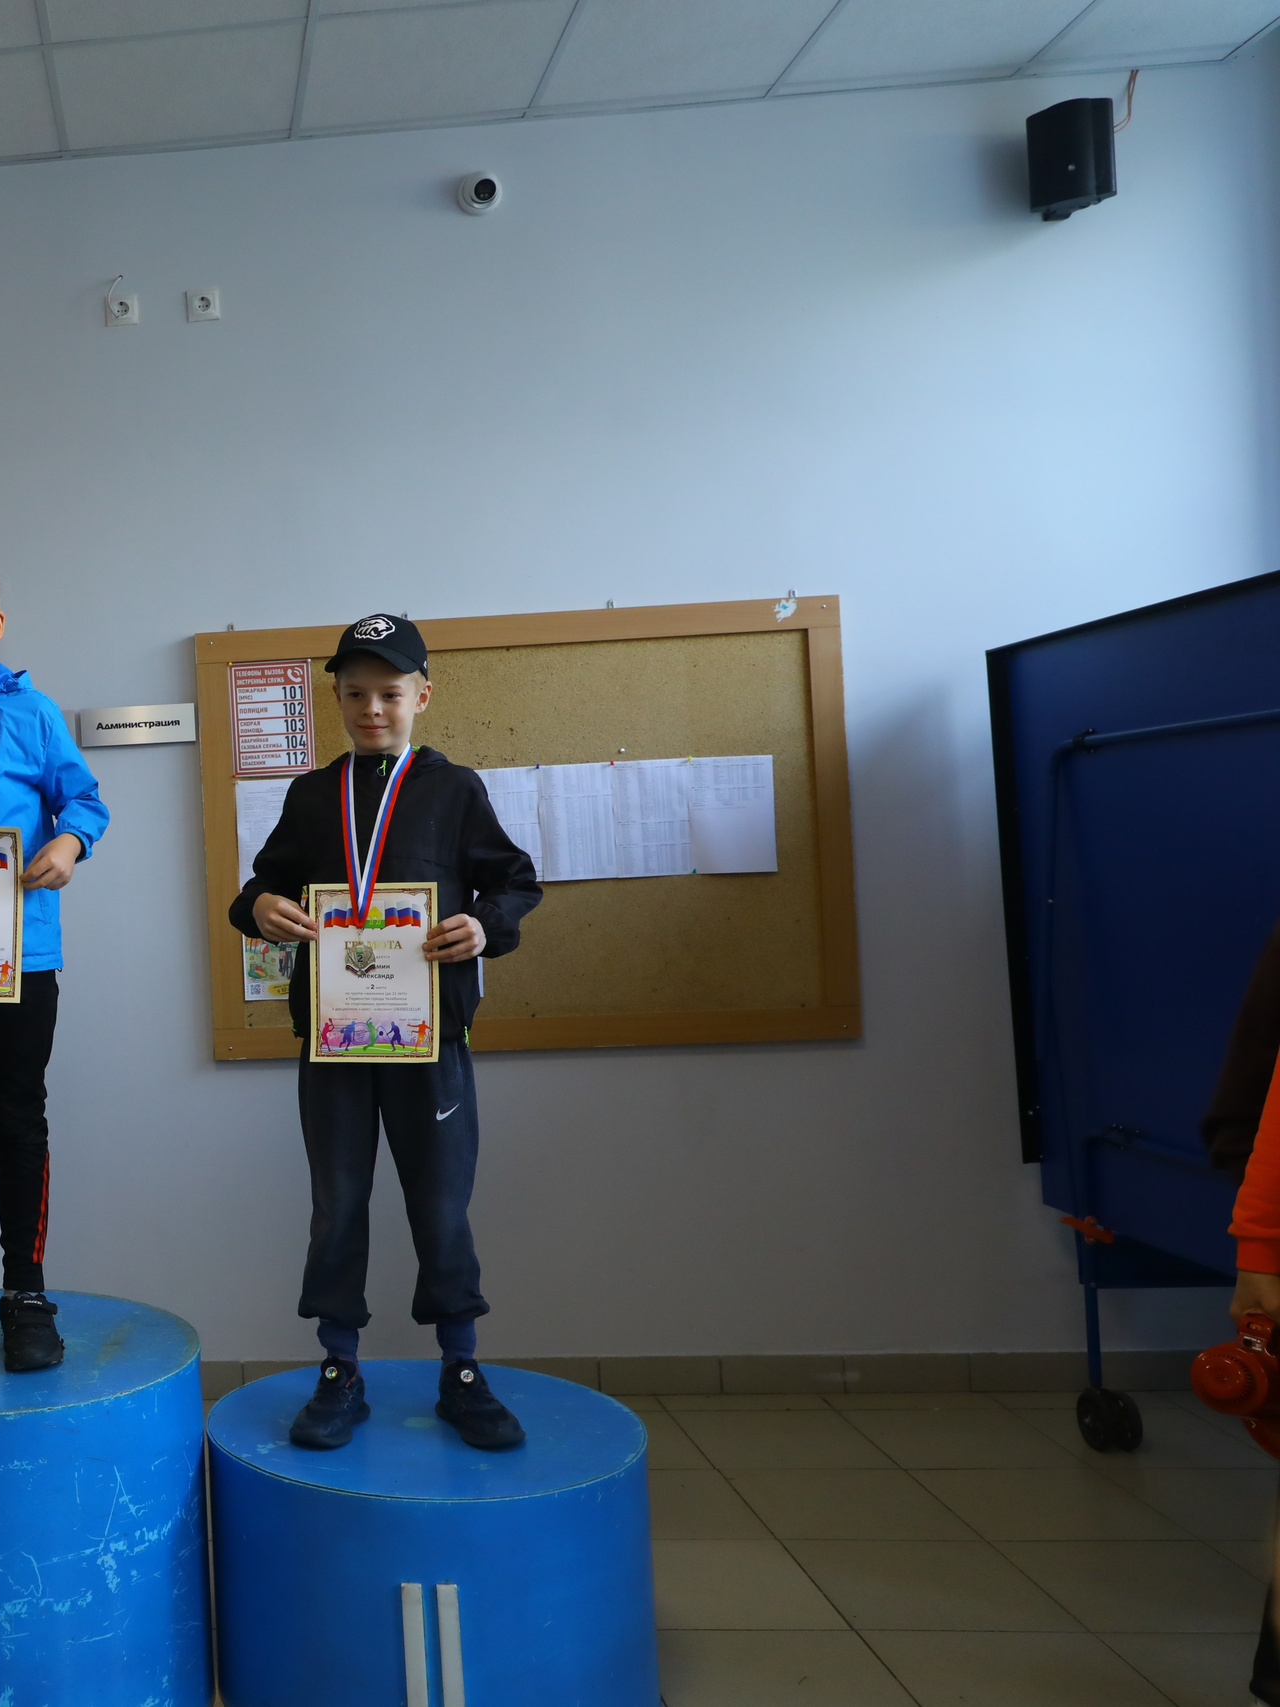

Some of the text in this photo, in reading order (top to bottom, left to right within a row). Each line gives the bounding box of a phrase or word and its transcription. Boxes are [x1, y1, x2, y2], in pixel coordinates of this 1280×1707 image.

[282, 685, 304, 700] 101
[239, 707, 268, 715] ПОЛИЦИЯ
[283, 702, 305, 716] 102
[96, 719, 180, 731] Администрация
[284, 718, 305, 733] 103
[285, 735, 307, 749] 104
[286, 751, 307, 766] 112
[357, 954, 364, 963] 2
